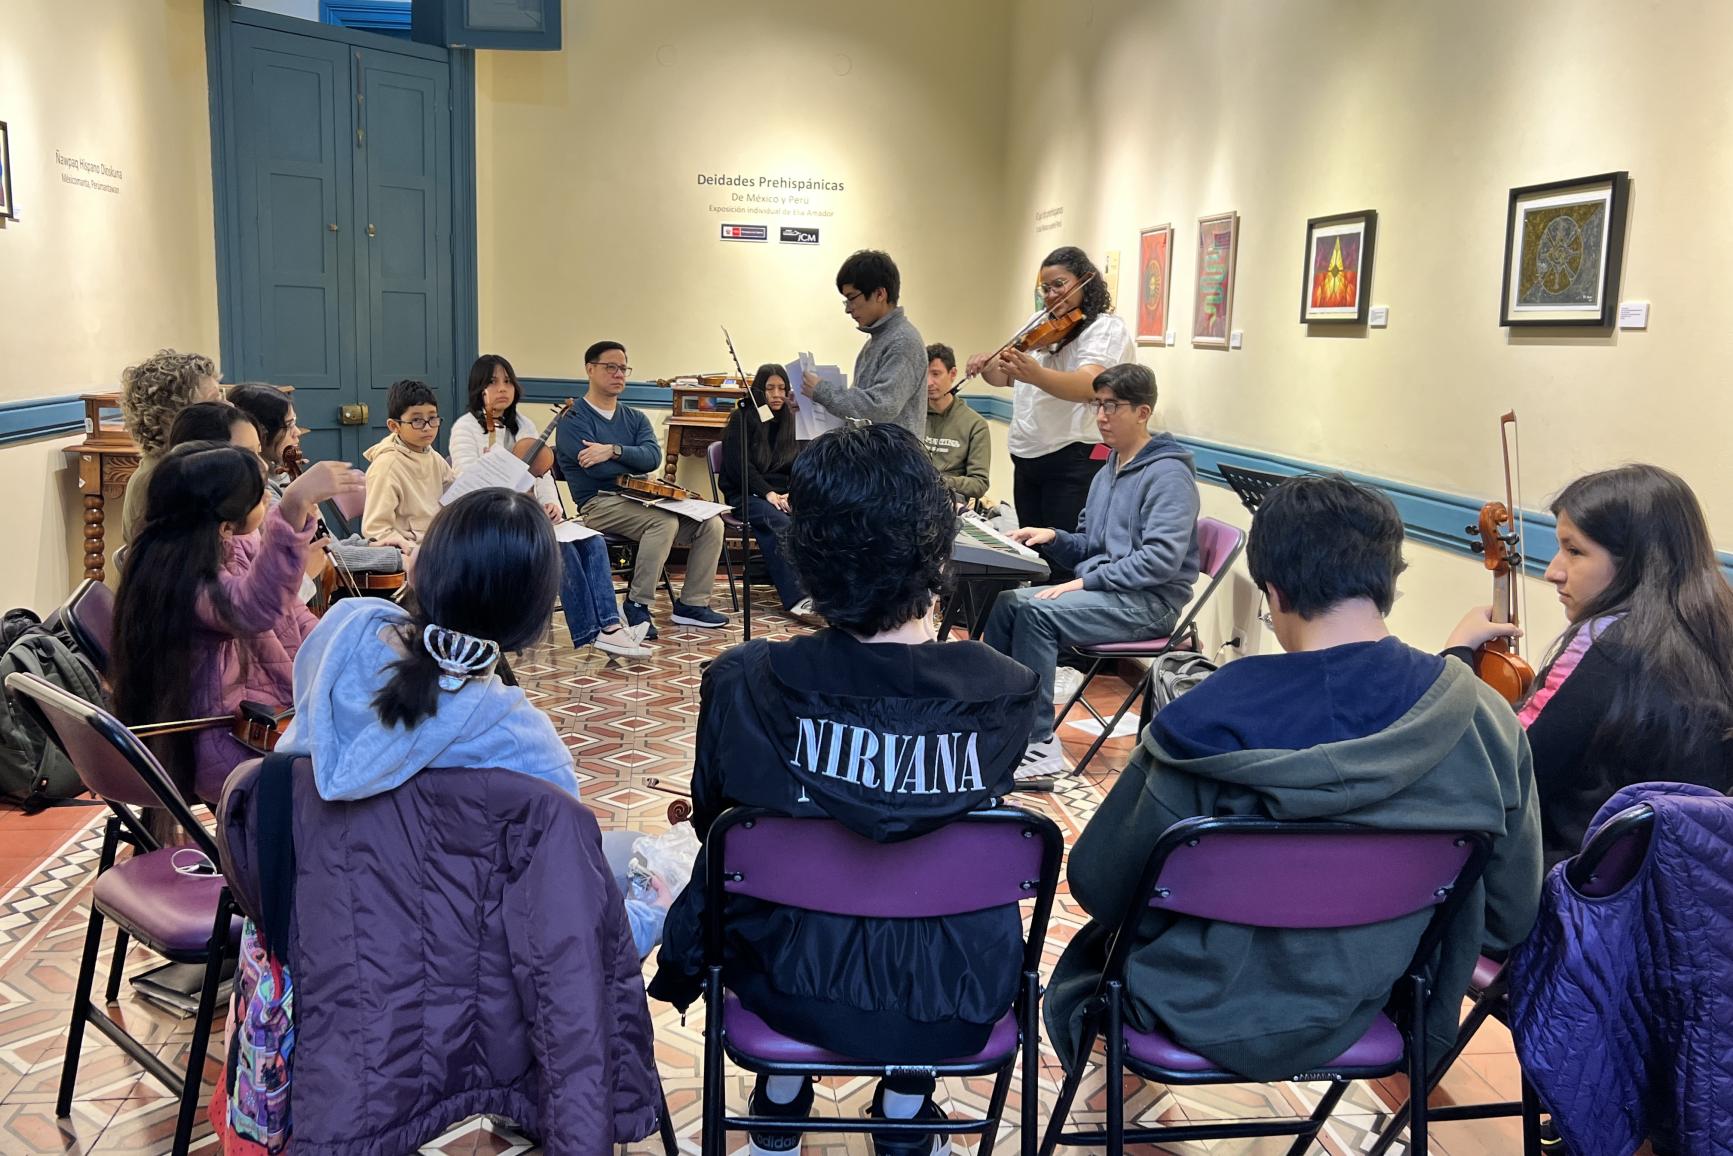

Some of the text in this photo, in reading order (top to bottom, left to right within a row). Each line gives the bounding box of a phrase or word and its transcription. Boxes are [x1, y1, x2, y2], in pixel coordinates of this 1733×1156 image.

[697, 174, 845, 192] Deidades Prehispánicas
[731, 192, 744, 202] De
[746, 193, 778, 204] México
[788, 195, 810, 205] Perú
[708, 204, 746, 214] Exposición
[790, 716, 987, 794] NIRVANA
[757, 1133, 797, 1149] adidas
